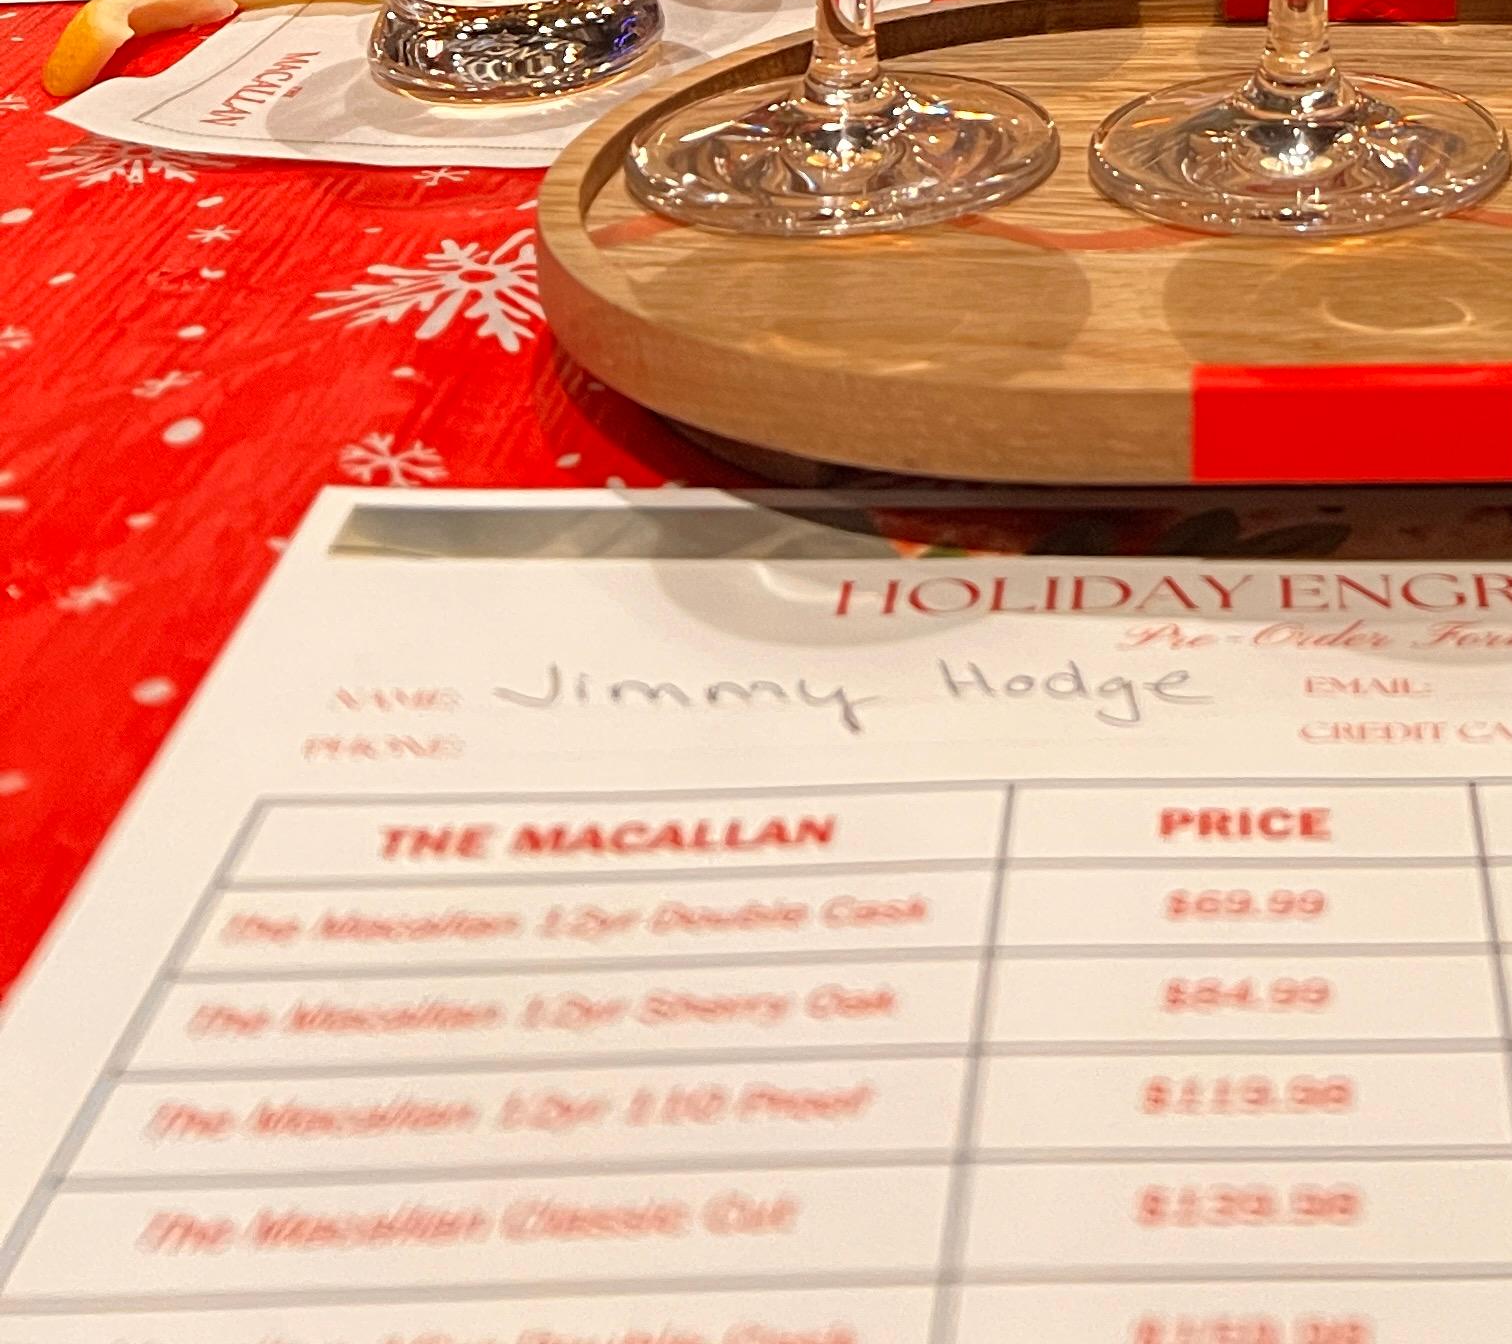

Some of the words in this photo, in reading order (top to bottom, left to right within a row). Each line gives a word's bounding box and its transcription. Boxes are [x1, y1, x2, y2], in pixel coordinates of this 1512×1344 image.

[199, 50, 322, 127] MACALLAN
[835, 574, 1253, 618] HOLIDAY
[1115, 618, 1394, 651] Pre-Order
[492, 660, 882, 736] Jimmy
[937, 657, 1215, 728] Hodge
[1298, 720, 1448, 745] CREDIT
[379, 822, 496, 861] THE
[509, 813, 838, 858] MACALLAN
[1158, 806, 1332, 840] PRICE
[649, 899, 809, 936] Double
[1163, 888, 1330, 923] $69.99
[1159, 977, 1336, 1013] $84.99
